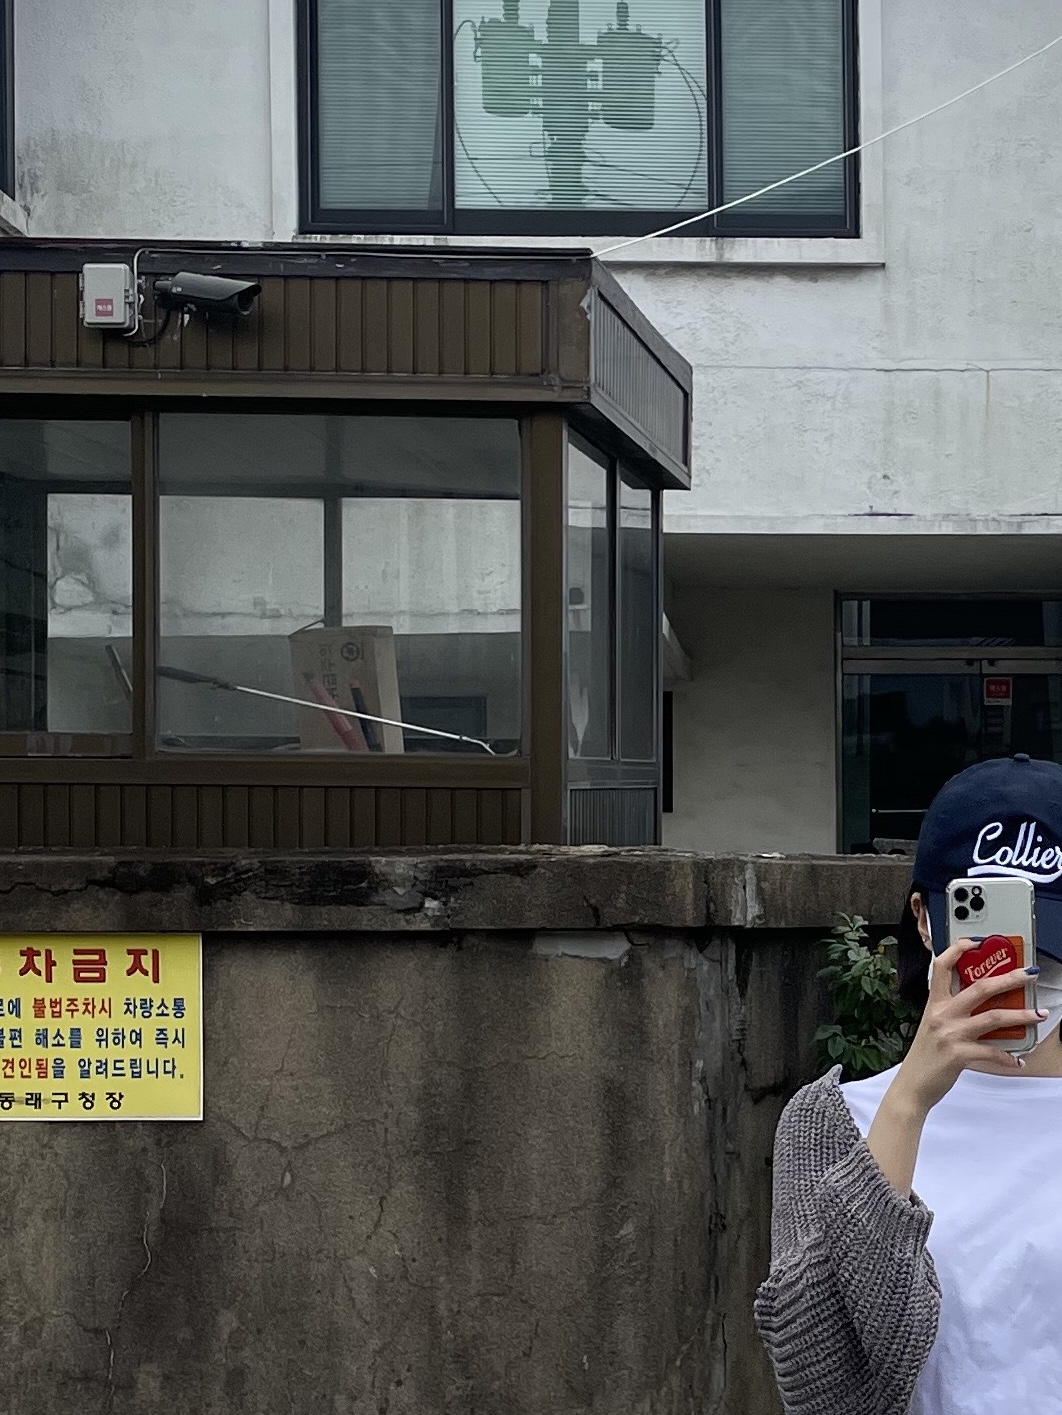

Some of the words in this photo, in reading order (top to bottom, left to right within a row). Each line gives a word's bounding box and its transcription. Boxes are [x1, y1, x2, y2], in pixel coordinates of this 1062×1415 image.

[963, 947, 1008, 982] Forever
[32, 997, 113, 1019] 불법주차시
[123, 997, 187, 1019] 차량소통
[34, 1027, 83, 1049] 해소를
[95, 1027, 143, 1049] 위하여
[154, 1027, 186, 1049] 즉시
[1, 1057, 66, 1079] 견인됨을
[77, 1057, 184, 1079] 알려드립니다.
[0, 1091, 125, 1111] 동래구청장
